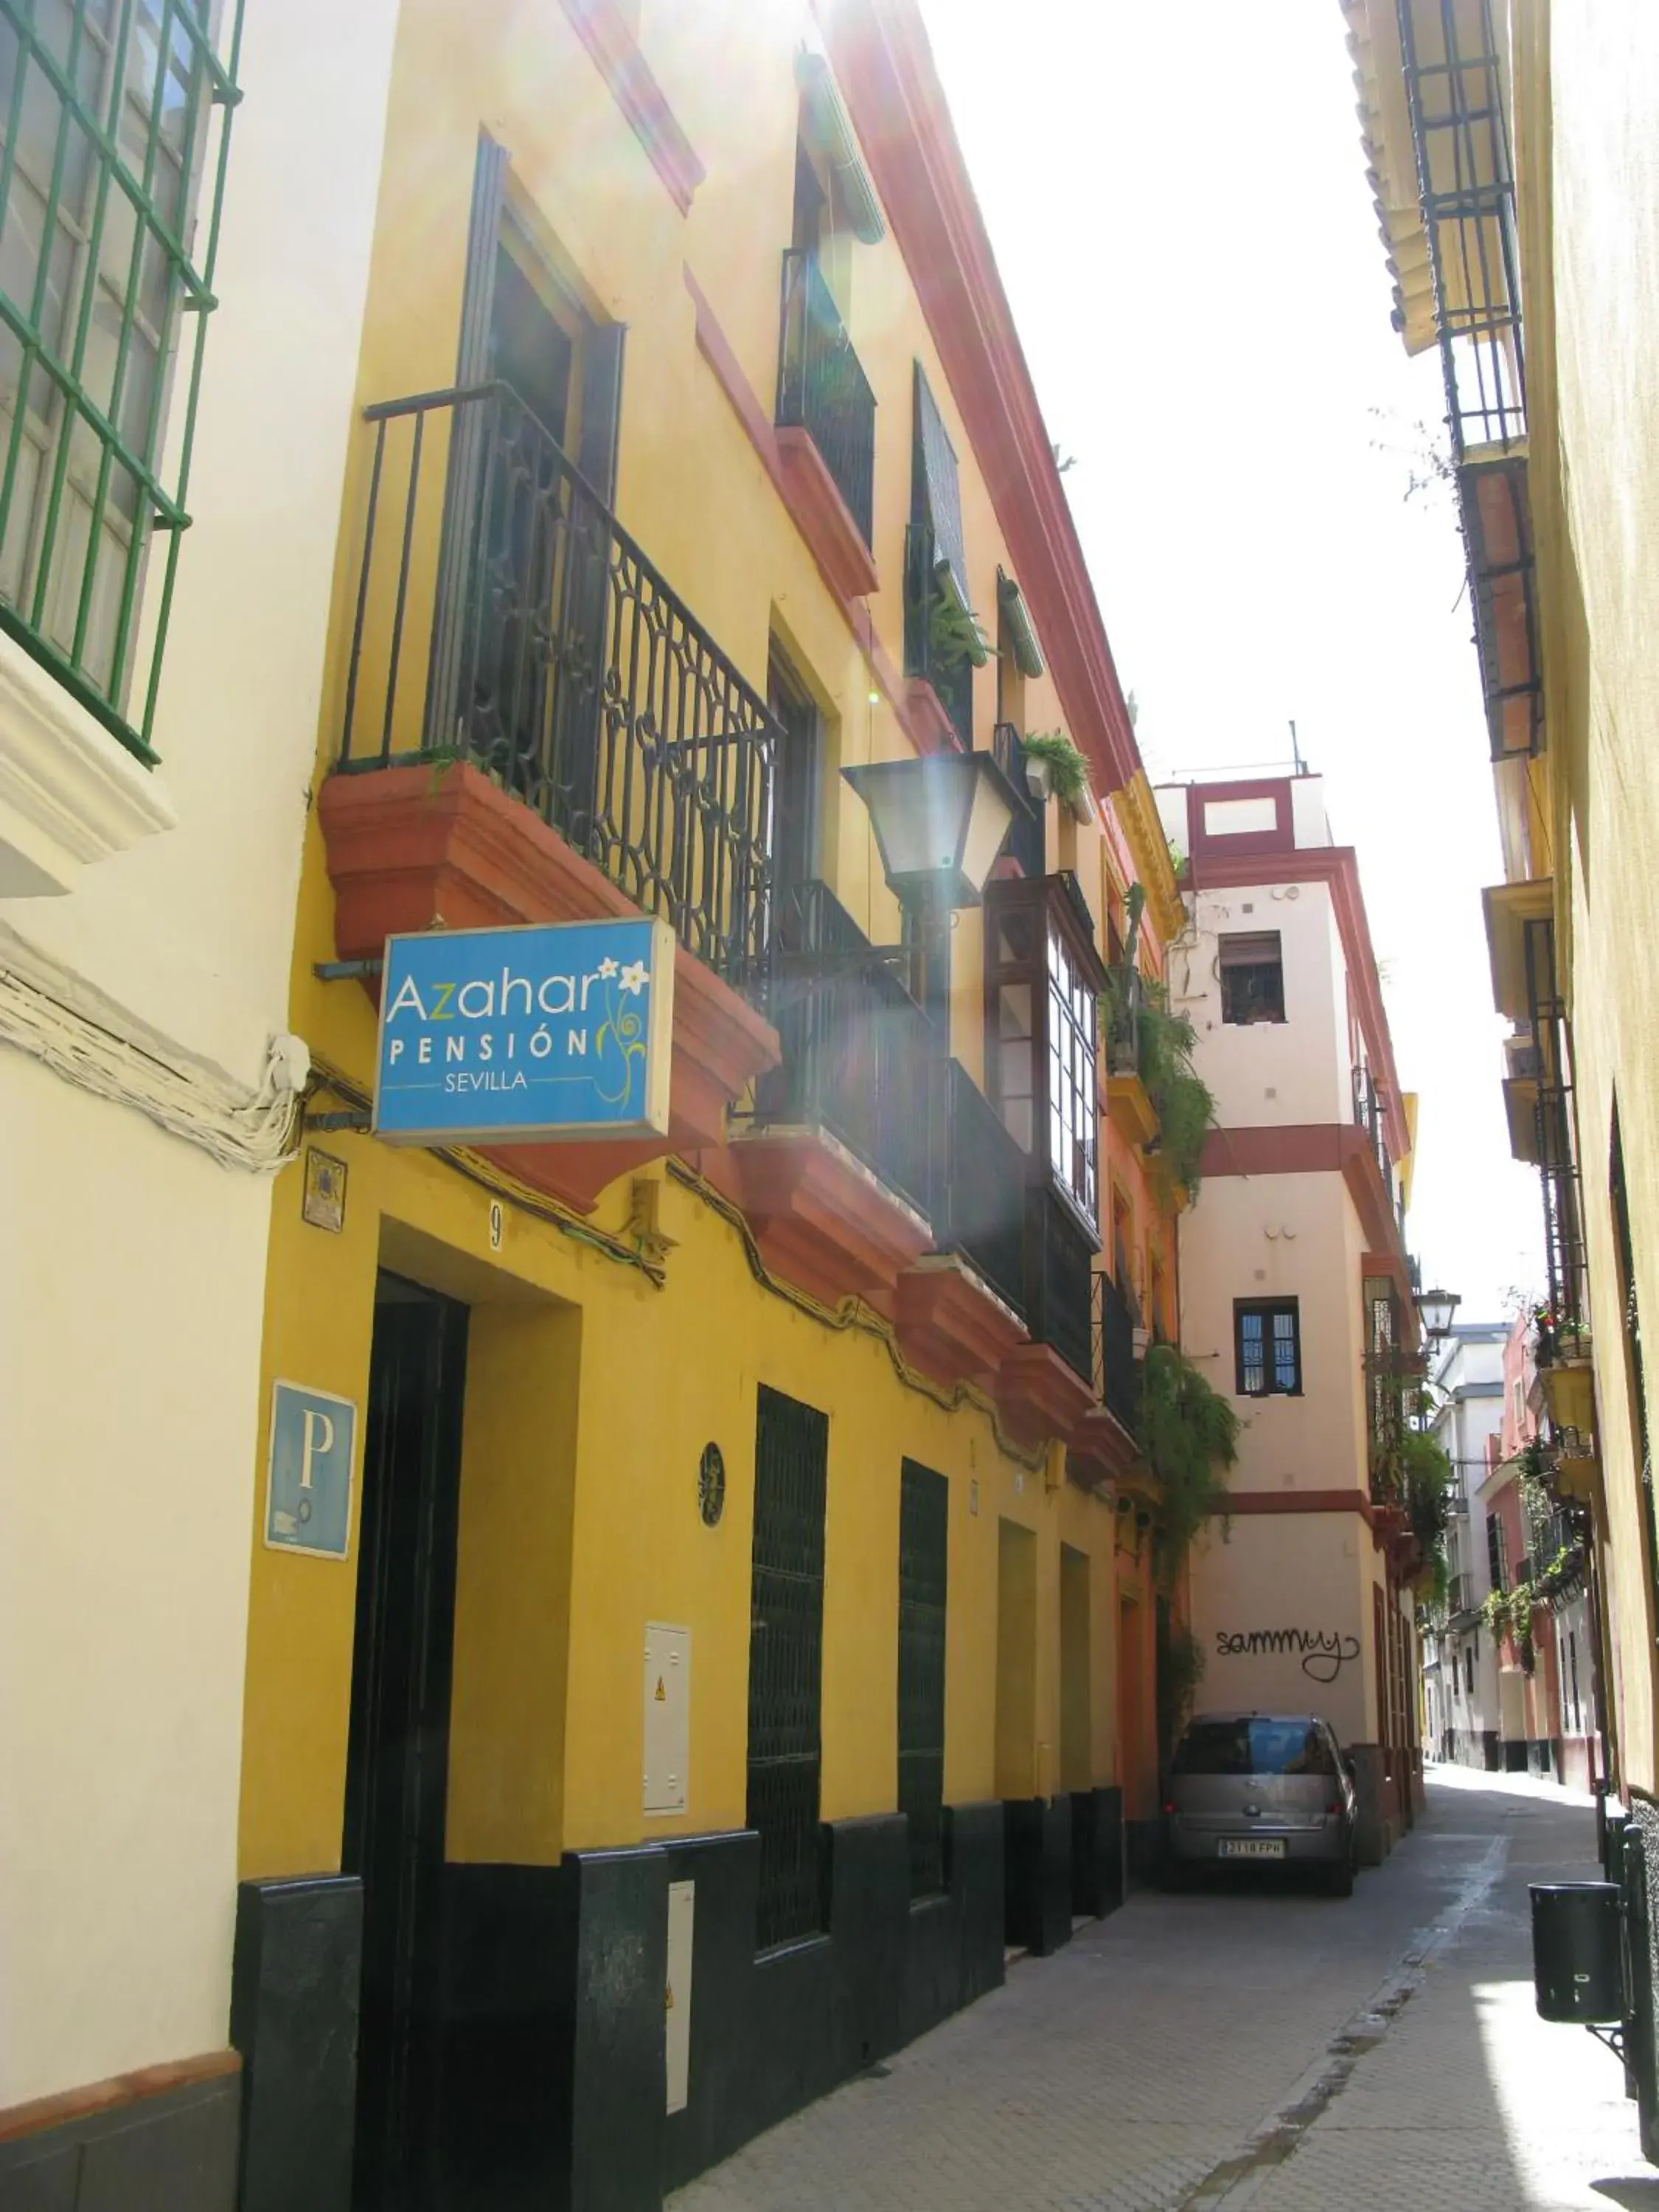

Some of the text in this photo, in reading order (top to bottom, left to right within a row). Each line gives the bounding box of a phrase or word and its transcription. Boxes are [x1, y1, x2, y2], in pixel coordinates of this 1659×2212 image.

[386, 966, 599, 1023] Azahar
[389, 1023, 587, 1065] PENSIÓN
[445, 1071, 527, 1093] SEVILLA
[491, 1204, 501, 1247] 9
[299, 1409, 334, 1489] P
